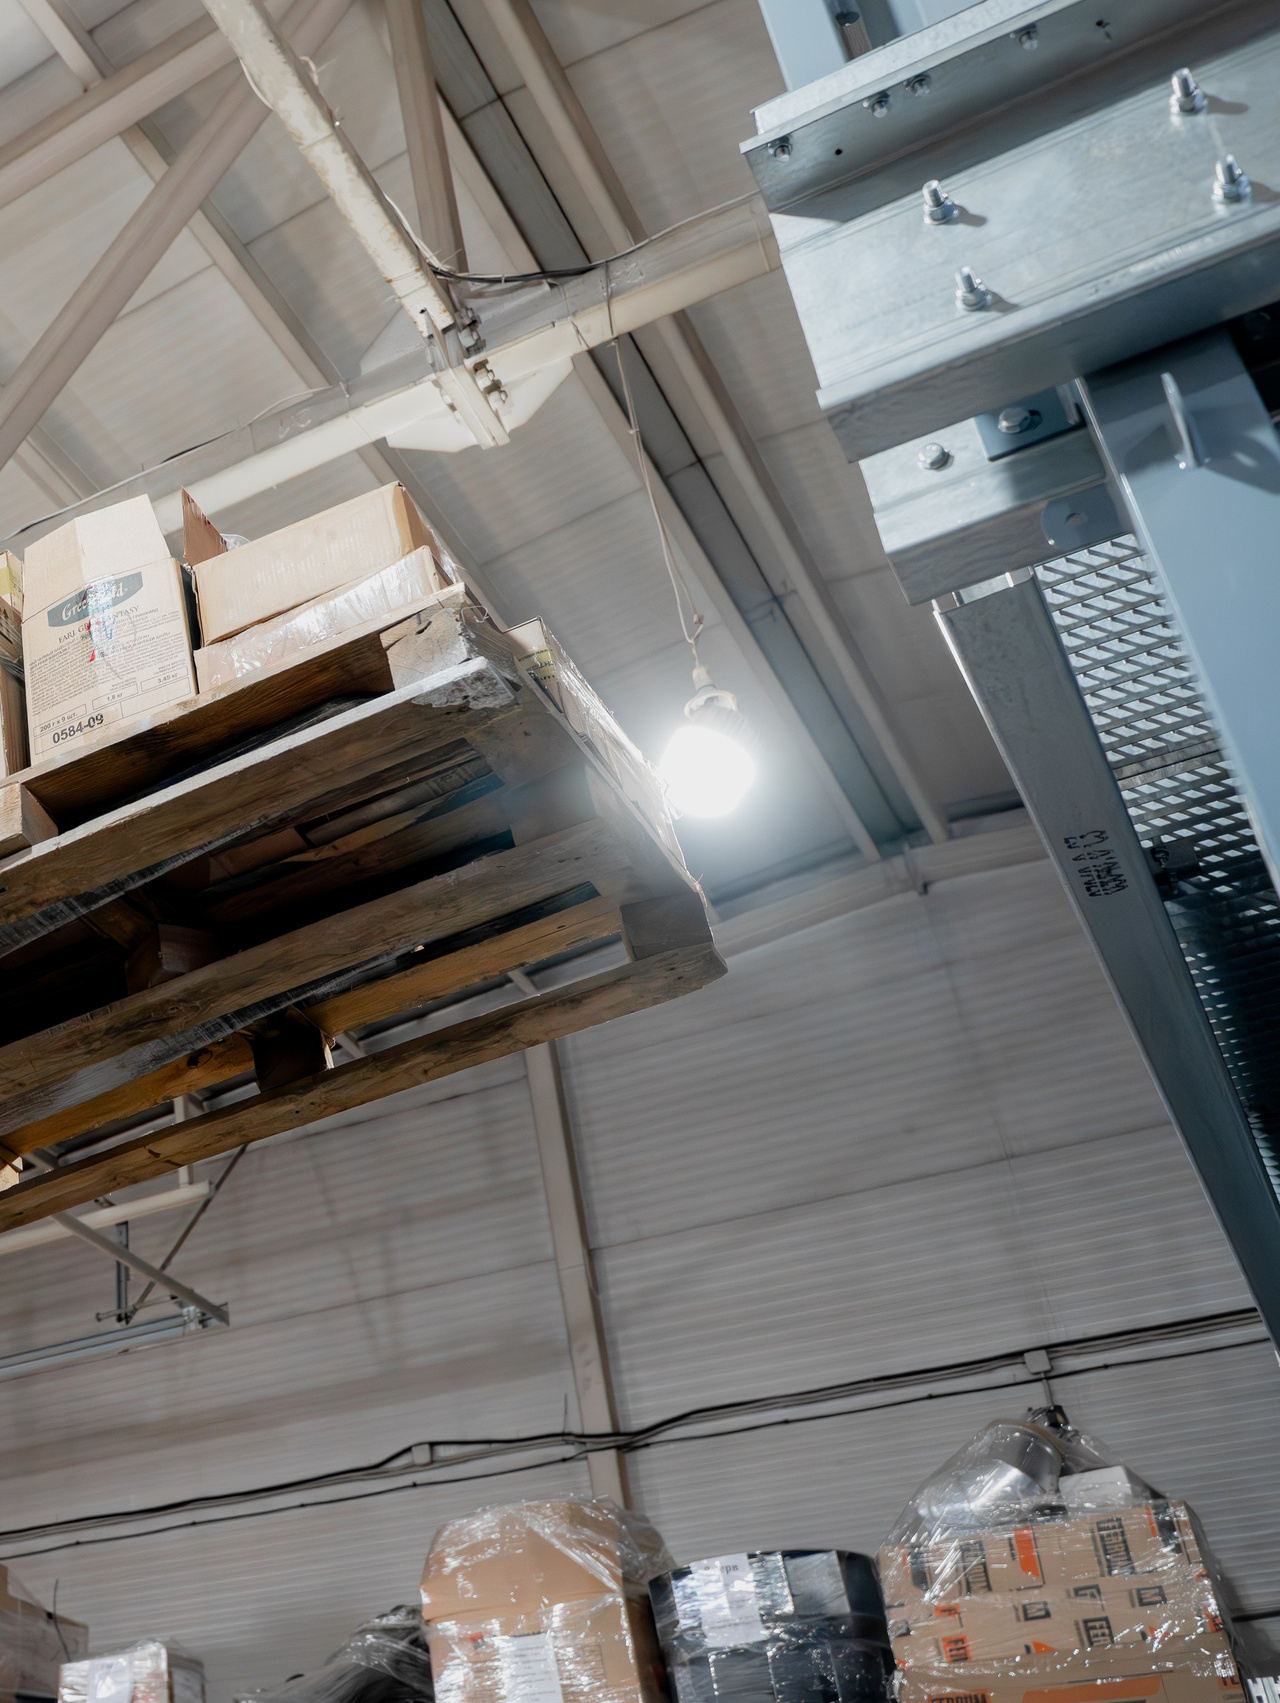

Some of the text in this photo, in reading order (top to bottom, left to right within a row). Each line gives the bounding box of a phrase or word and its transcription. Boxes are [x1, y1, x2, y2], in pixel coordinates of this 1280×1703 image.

[61, 584, 124, 621] Greeld
[58, 630, 77, 644] EARL
[106, 605, 139, 621] ANTASY
[157, 675, 171, 684] 3,45
[107, 693, 116, 702] 1,8
[40, 722, 52, 733] 200
[52, 713, 104, 744] 0584-09
